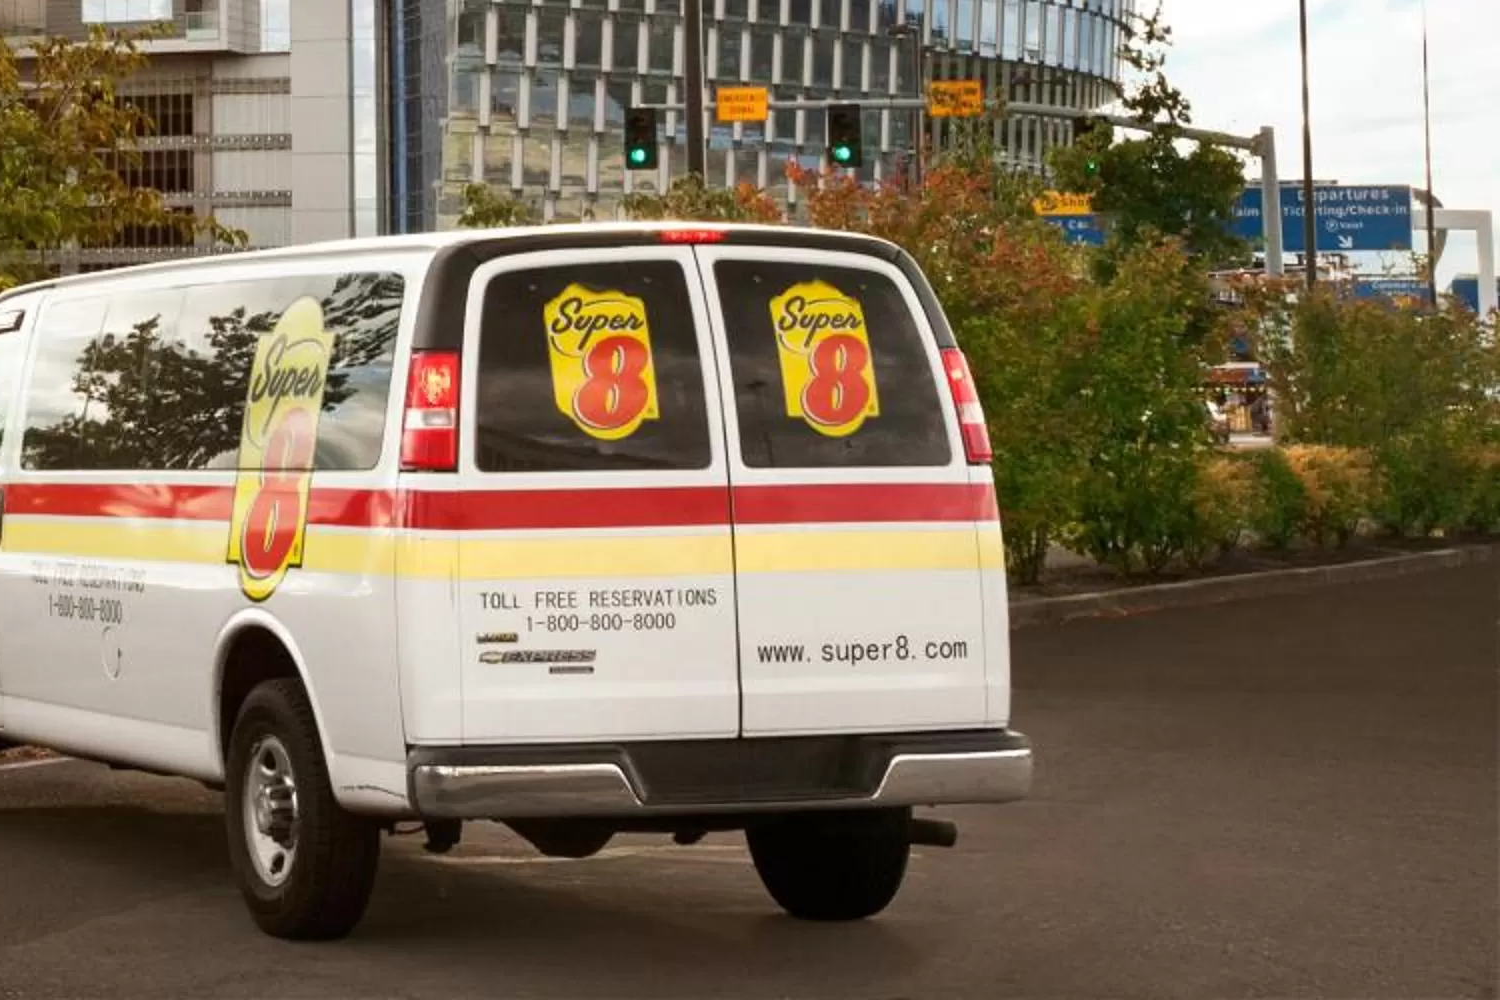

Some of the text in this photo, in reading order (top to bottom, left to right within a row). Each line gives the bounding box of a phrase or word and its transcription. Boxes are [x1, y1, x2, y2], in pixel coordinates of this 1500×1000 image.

[1230, 204, 1260, 217] laim
[1297, 188, 1390, 203] Dpartures
[551, 297, 644, 351] Super
[779, 295, 863, 349] Super
[252, 334, 323, 436] Super
[572, 334, 650, 430] 8
[801, 333, 870, 427] 8
[240, 406, 314, 580] 8
[479, 588, 718, 610] TOLL FREE RESERVATIONS
[526, 612, 676, 632] 1-800-800-8000
